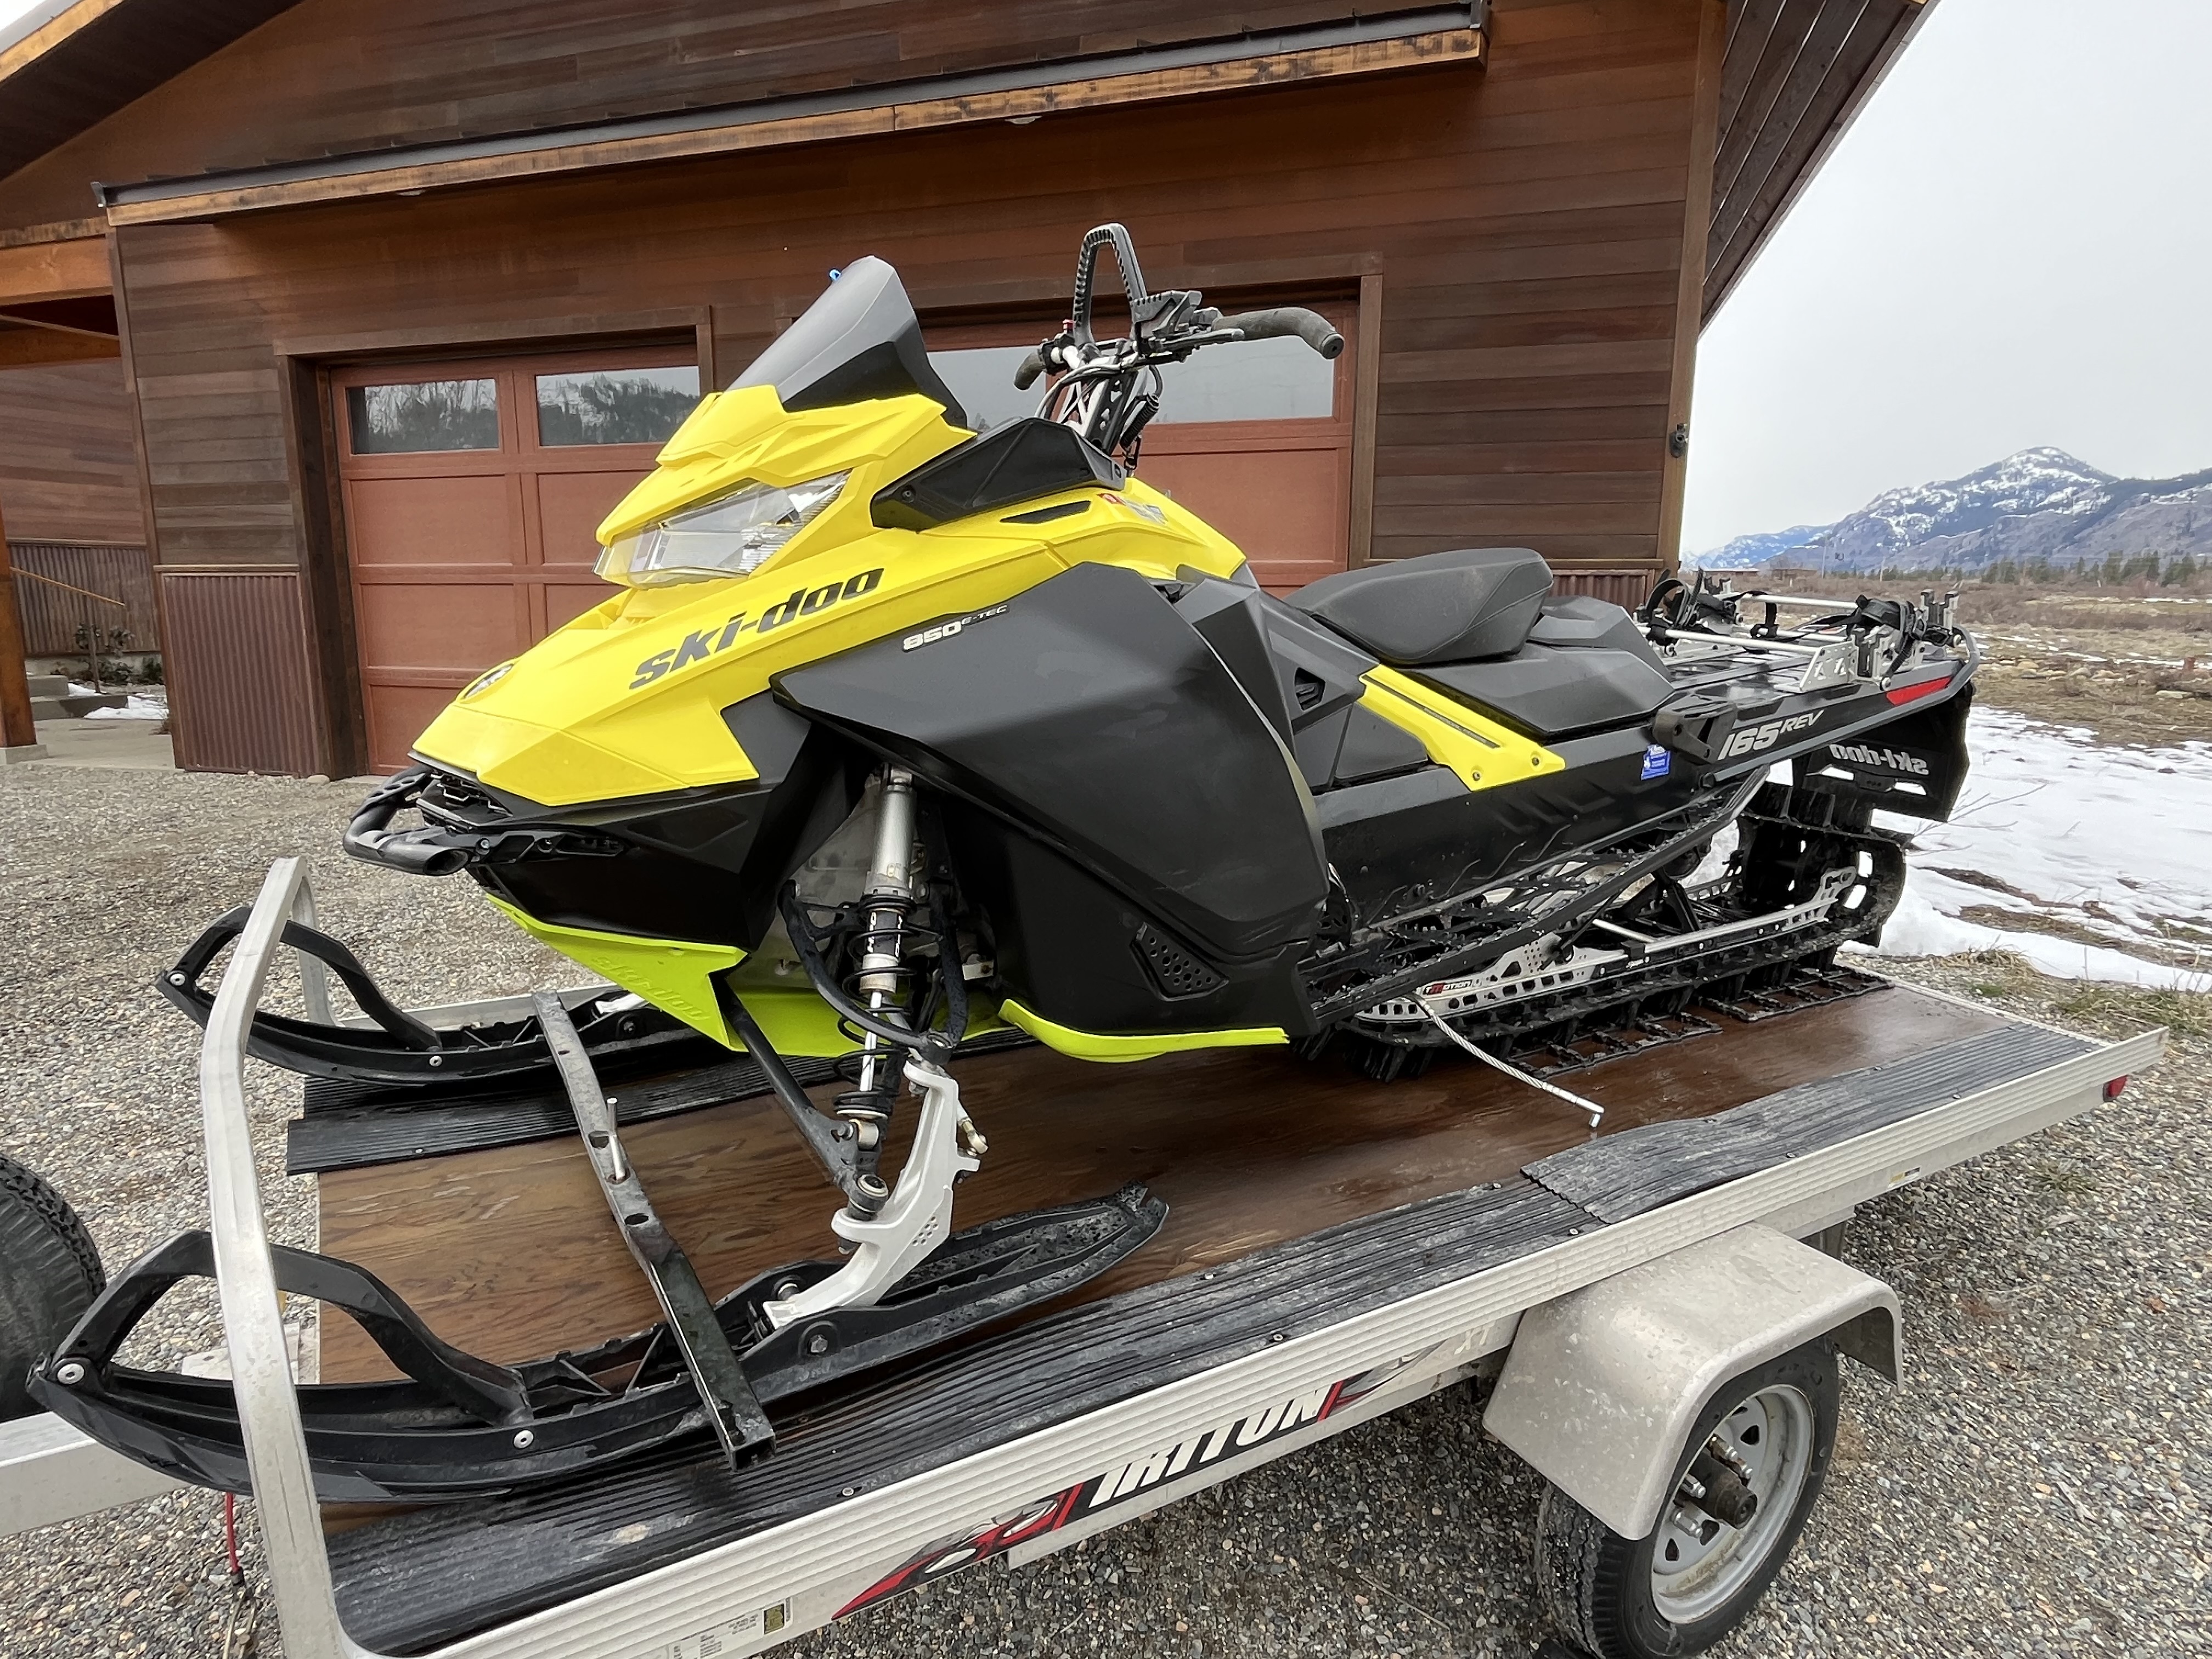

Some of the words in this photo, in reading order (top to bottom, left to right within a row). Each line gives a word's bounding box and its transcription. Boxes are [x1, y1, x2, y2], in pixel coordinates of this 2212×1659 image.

[903, 621, 961, 650] 850
[1717, 721, 1782, 760] 165
[1780, 709, 1825, 733] REV
